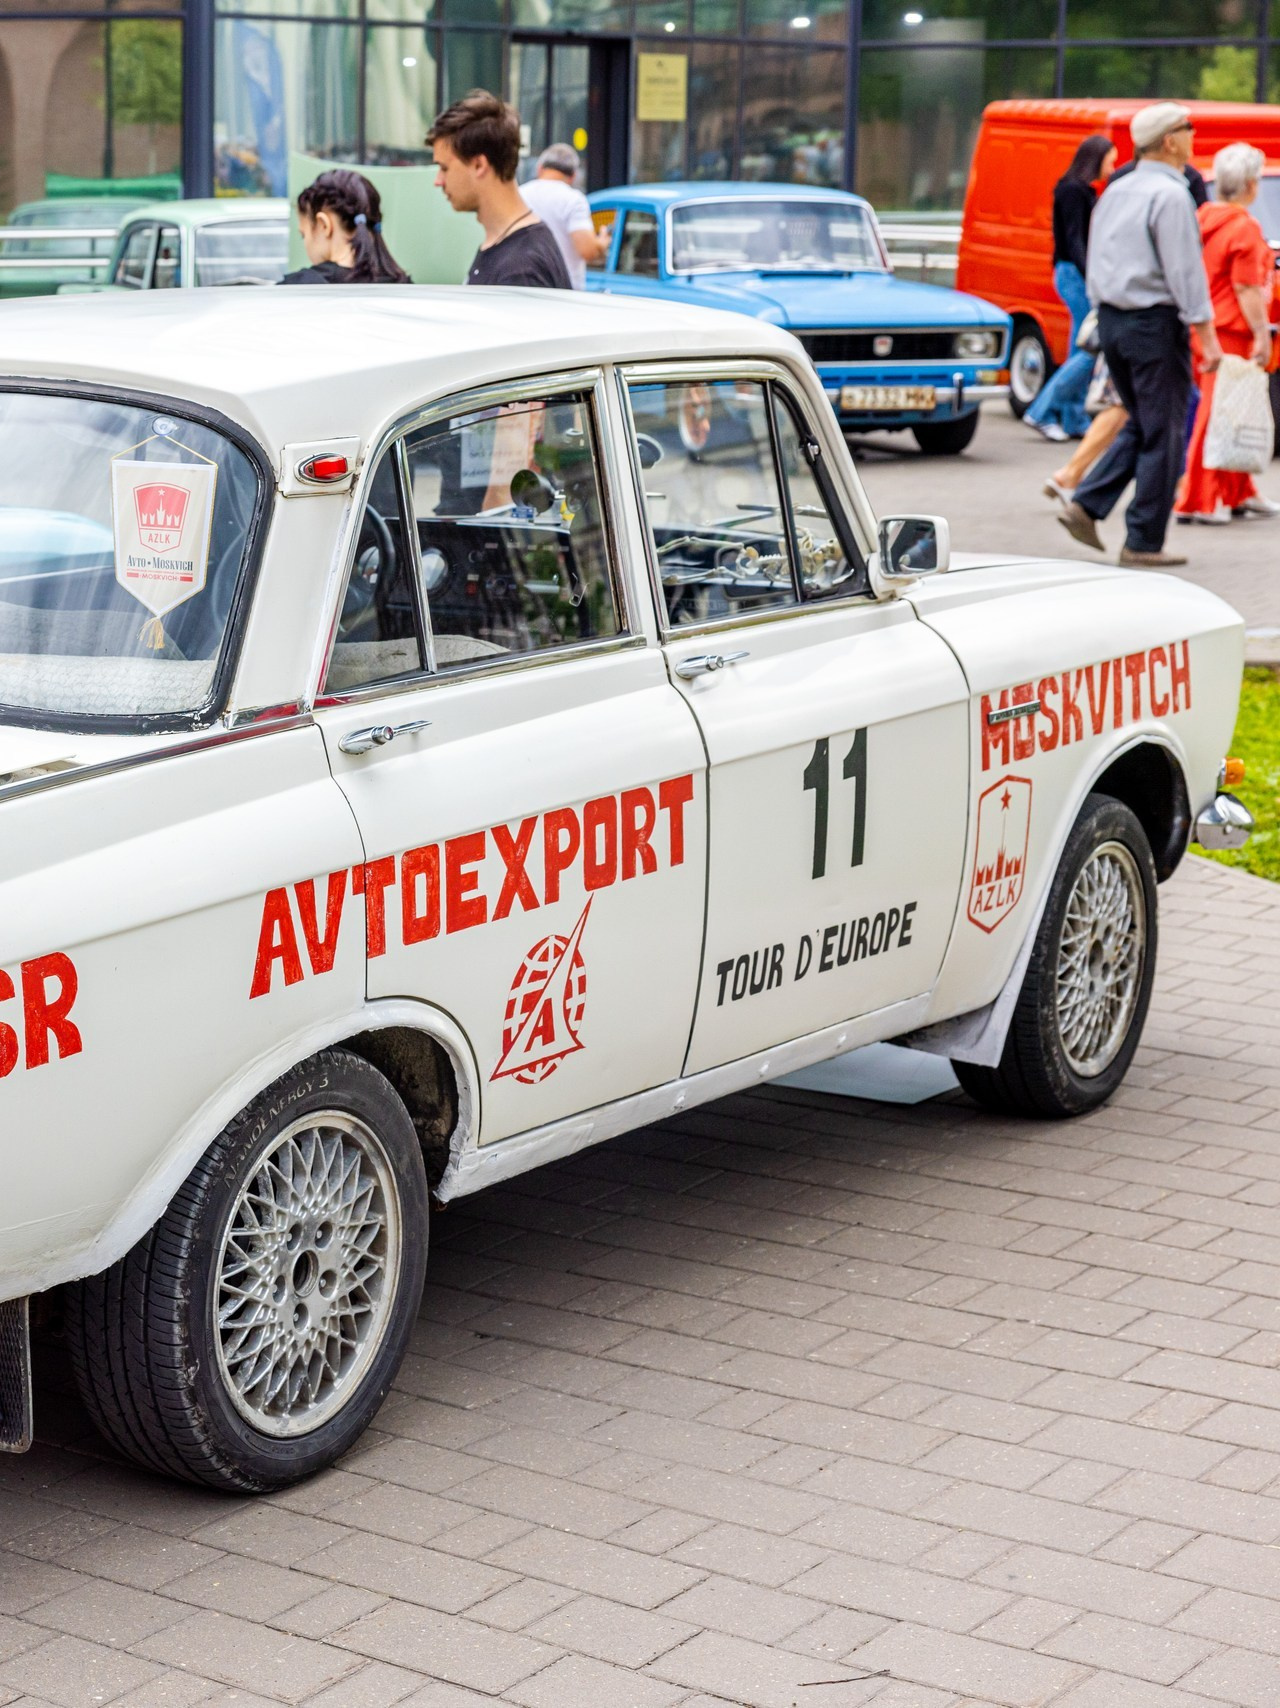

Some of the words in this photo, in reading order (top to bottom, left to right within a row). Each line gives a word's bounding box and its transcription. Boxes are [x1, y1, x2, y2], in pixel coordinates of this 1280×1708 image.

[148, 533, 171, 544] AZLK
[980, 639, 1192, 772] MOSKVITCH
[803, 726, 868, 880] 11
[248, 773, 694, 1000] AVTOEXPORT
[972, 879, 1019, 915] AZLK
[716, 943, 784, 1007] TOUR
